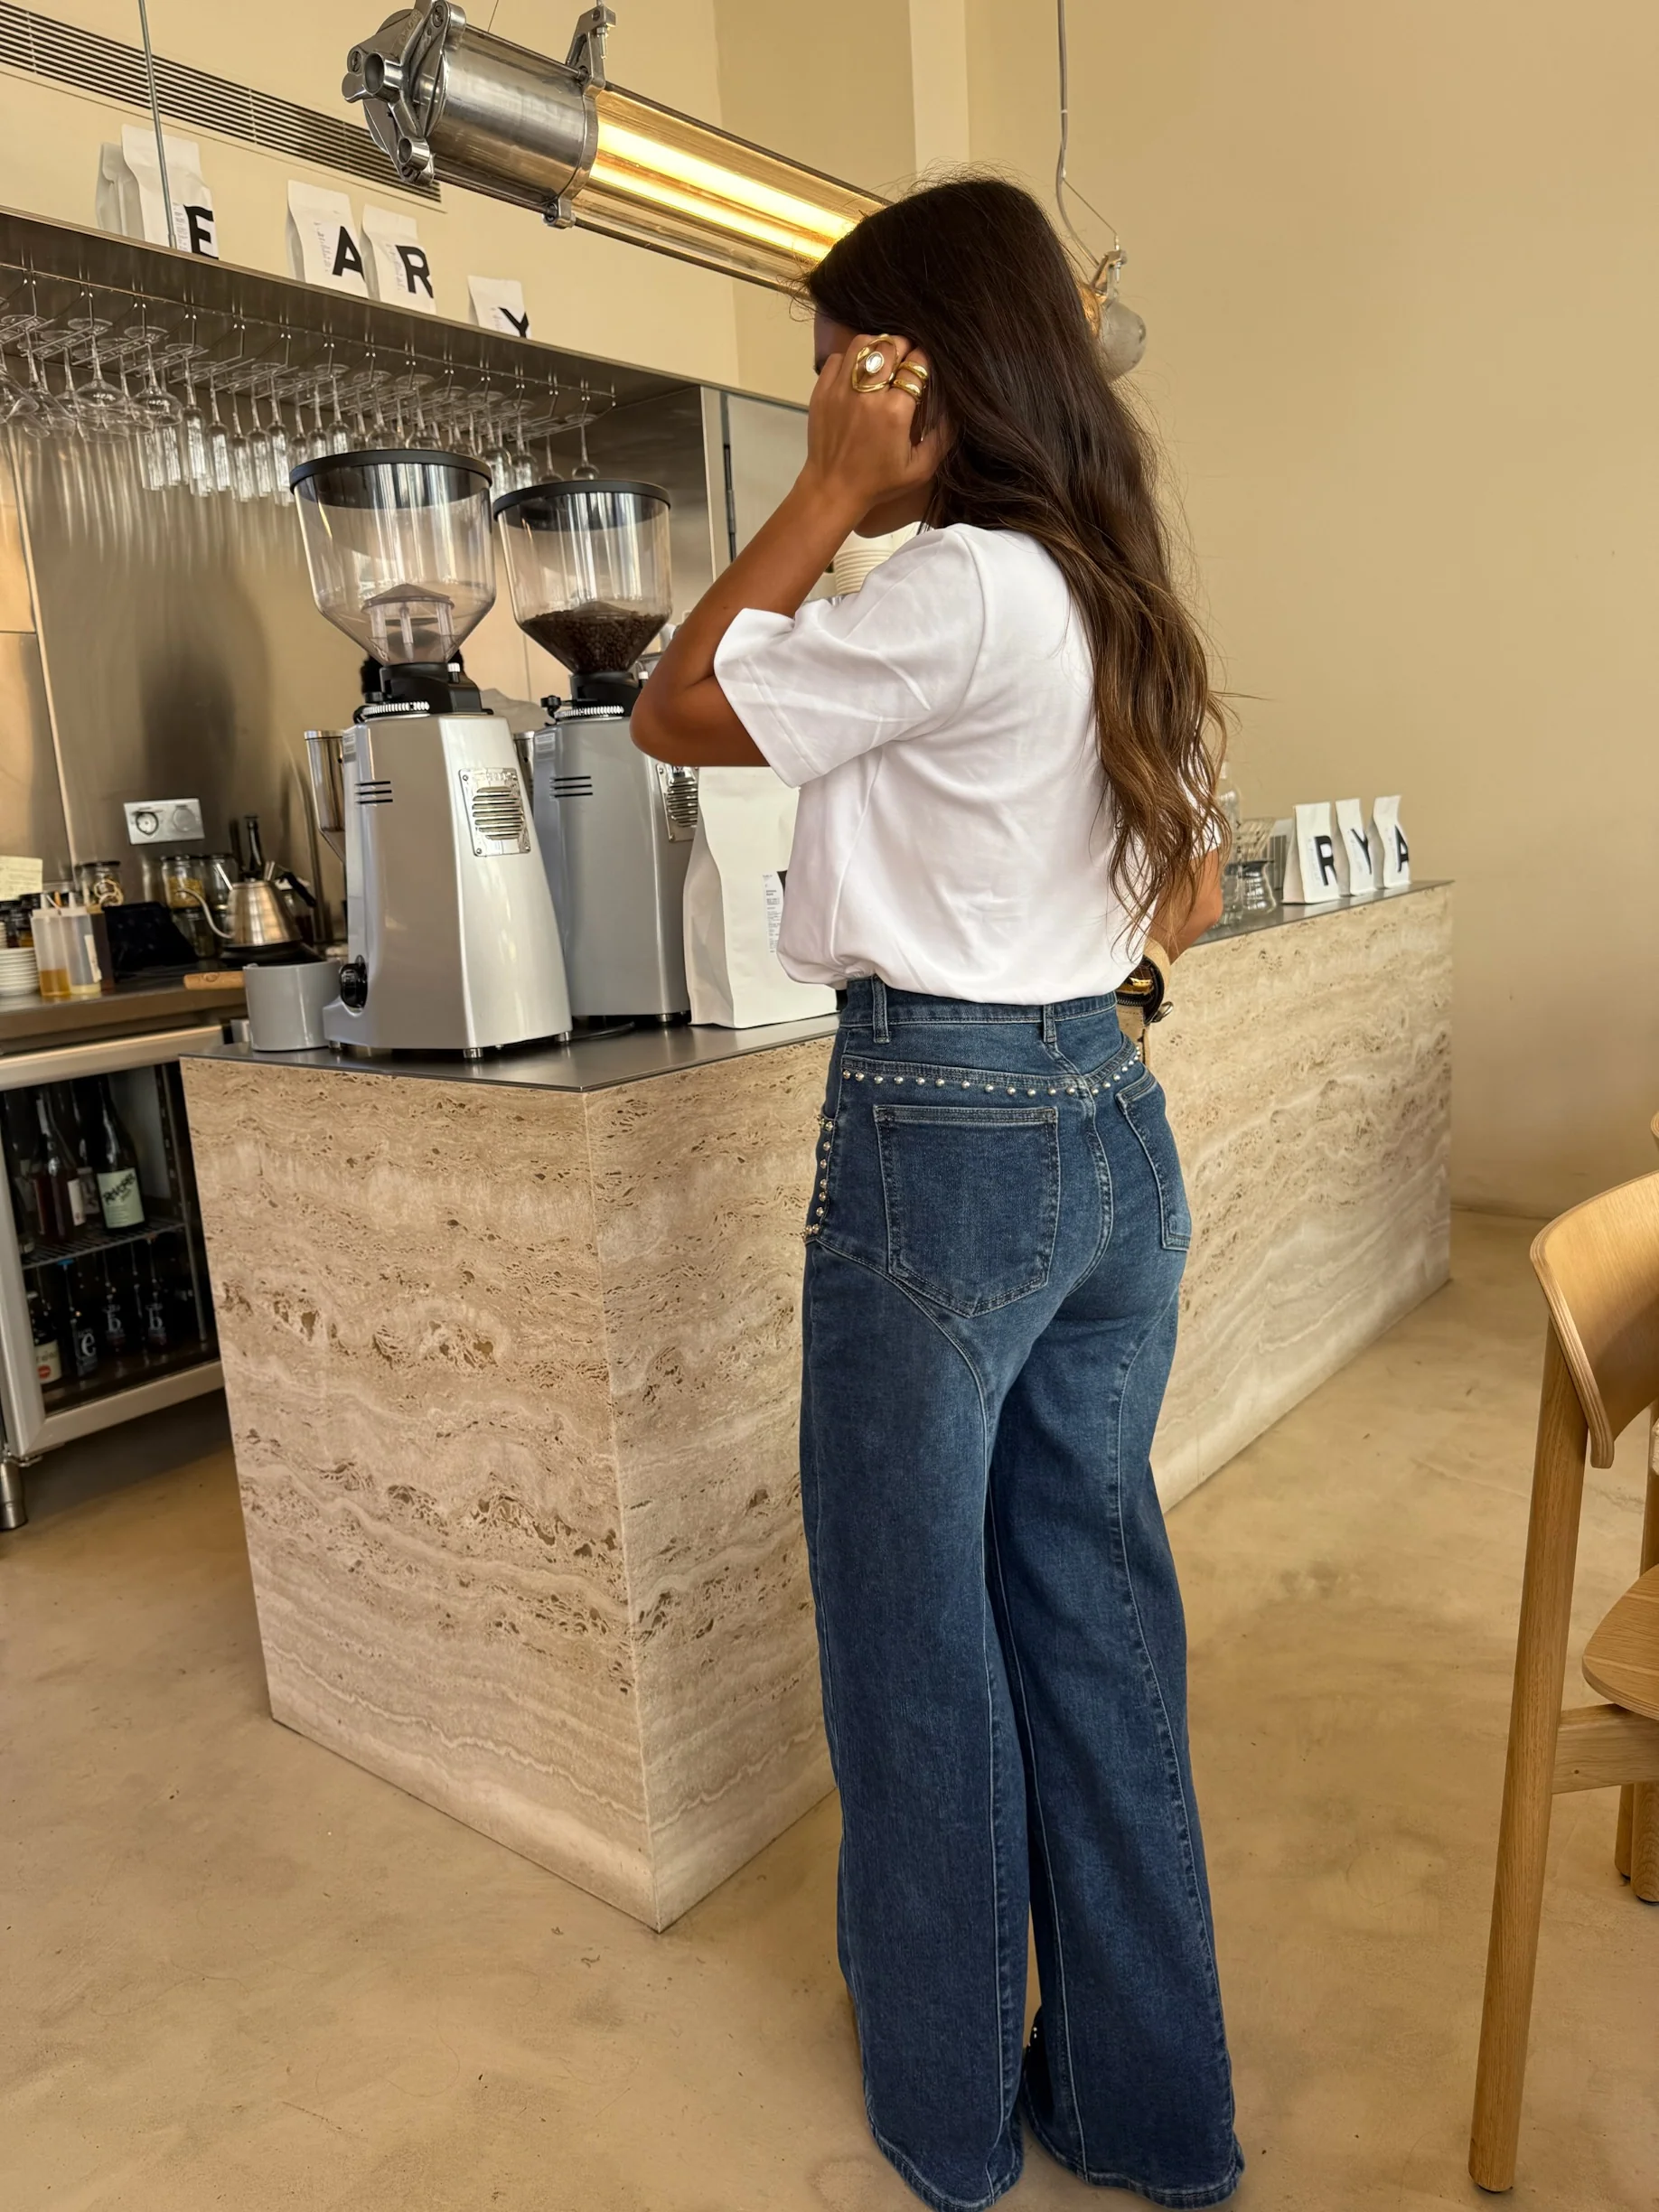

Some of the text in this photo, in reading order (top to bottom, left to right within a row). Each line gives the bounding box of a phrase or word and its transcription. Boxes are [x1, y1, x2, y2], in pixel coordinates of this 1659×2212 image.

[183, 204, 219, 260] E
[332, 225, 366, 283] A
[395, 244, 434, 299] R
[498, 306, 529, 338] Y
[1314, 835, 1337, 886] R
[1351, 828, 1372, 875] Y
[1393, 824, 1410, 873] A
